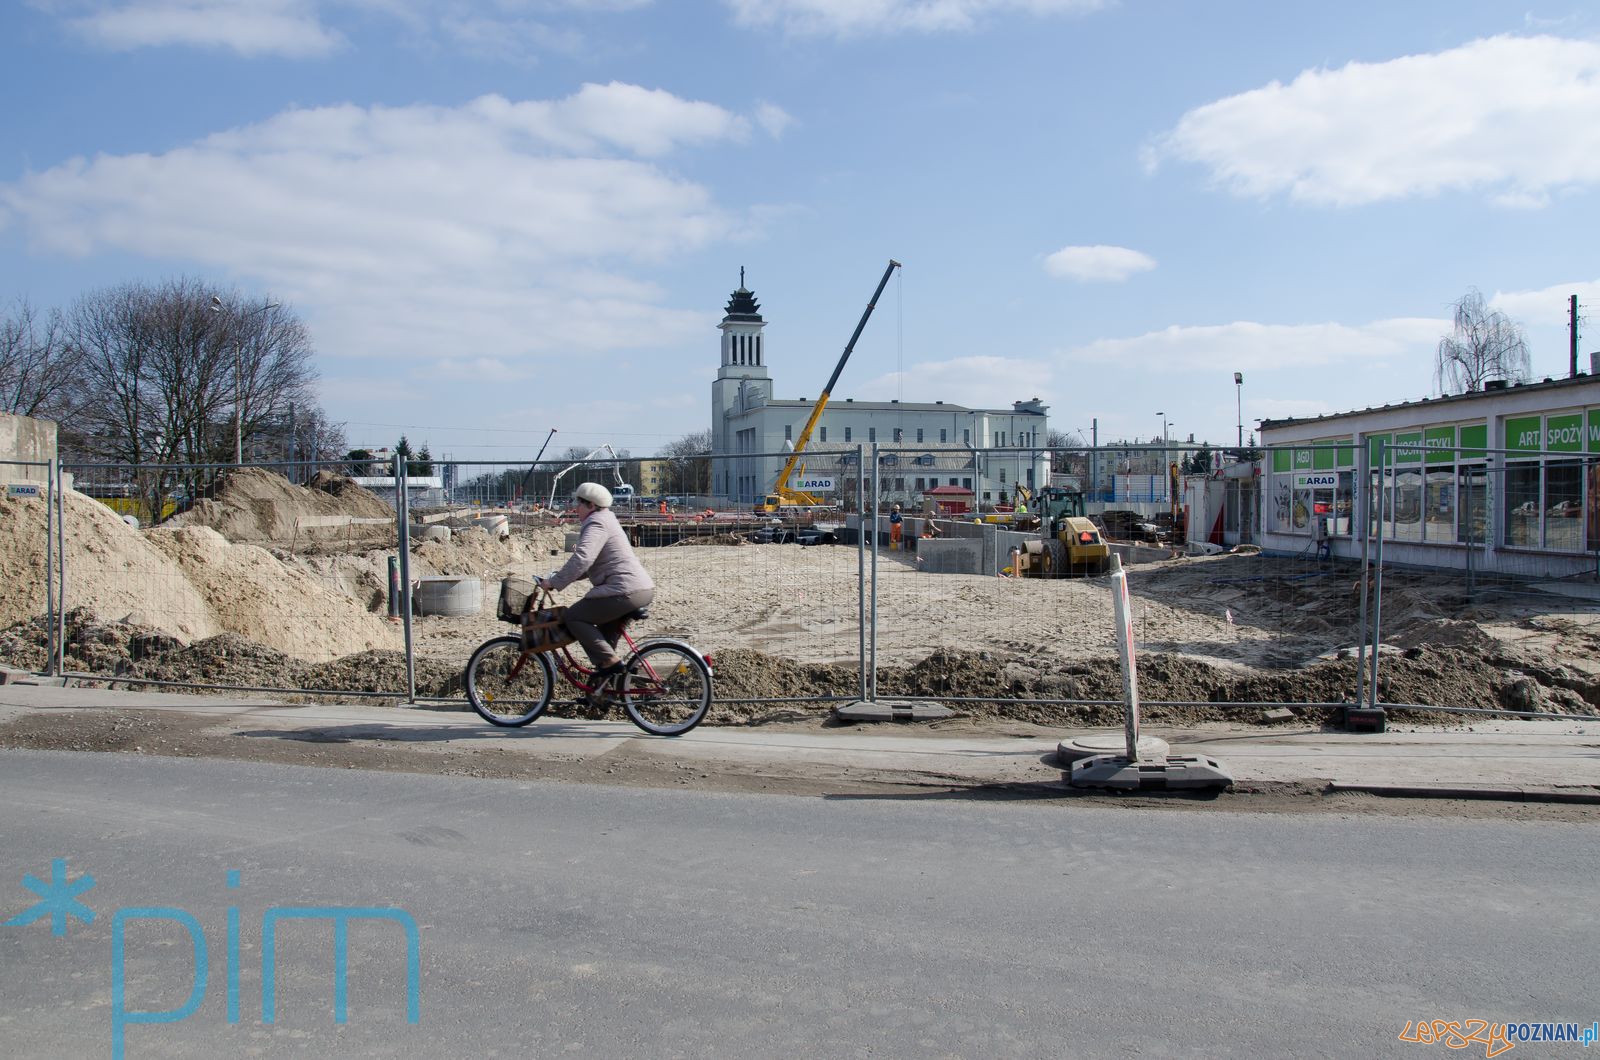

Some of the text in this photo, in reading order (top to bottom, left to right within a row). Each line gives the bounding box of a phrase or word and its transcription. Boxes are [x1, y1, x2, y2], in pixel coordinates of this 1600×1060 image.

[1519, 431, 1541, 447] ART.
[804, 480, 831, 488] ARAD
[1306, 477, 1335, 485] ARAD
